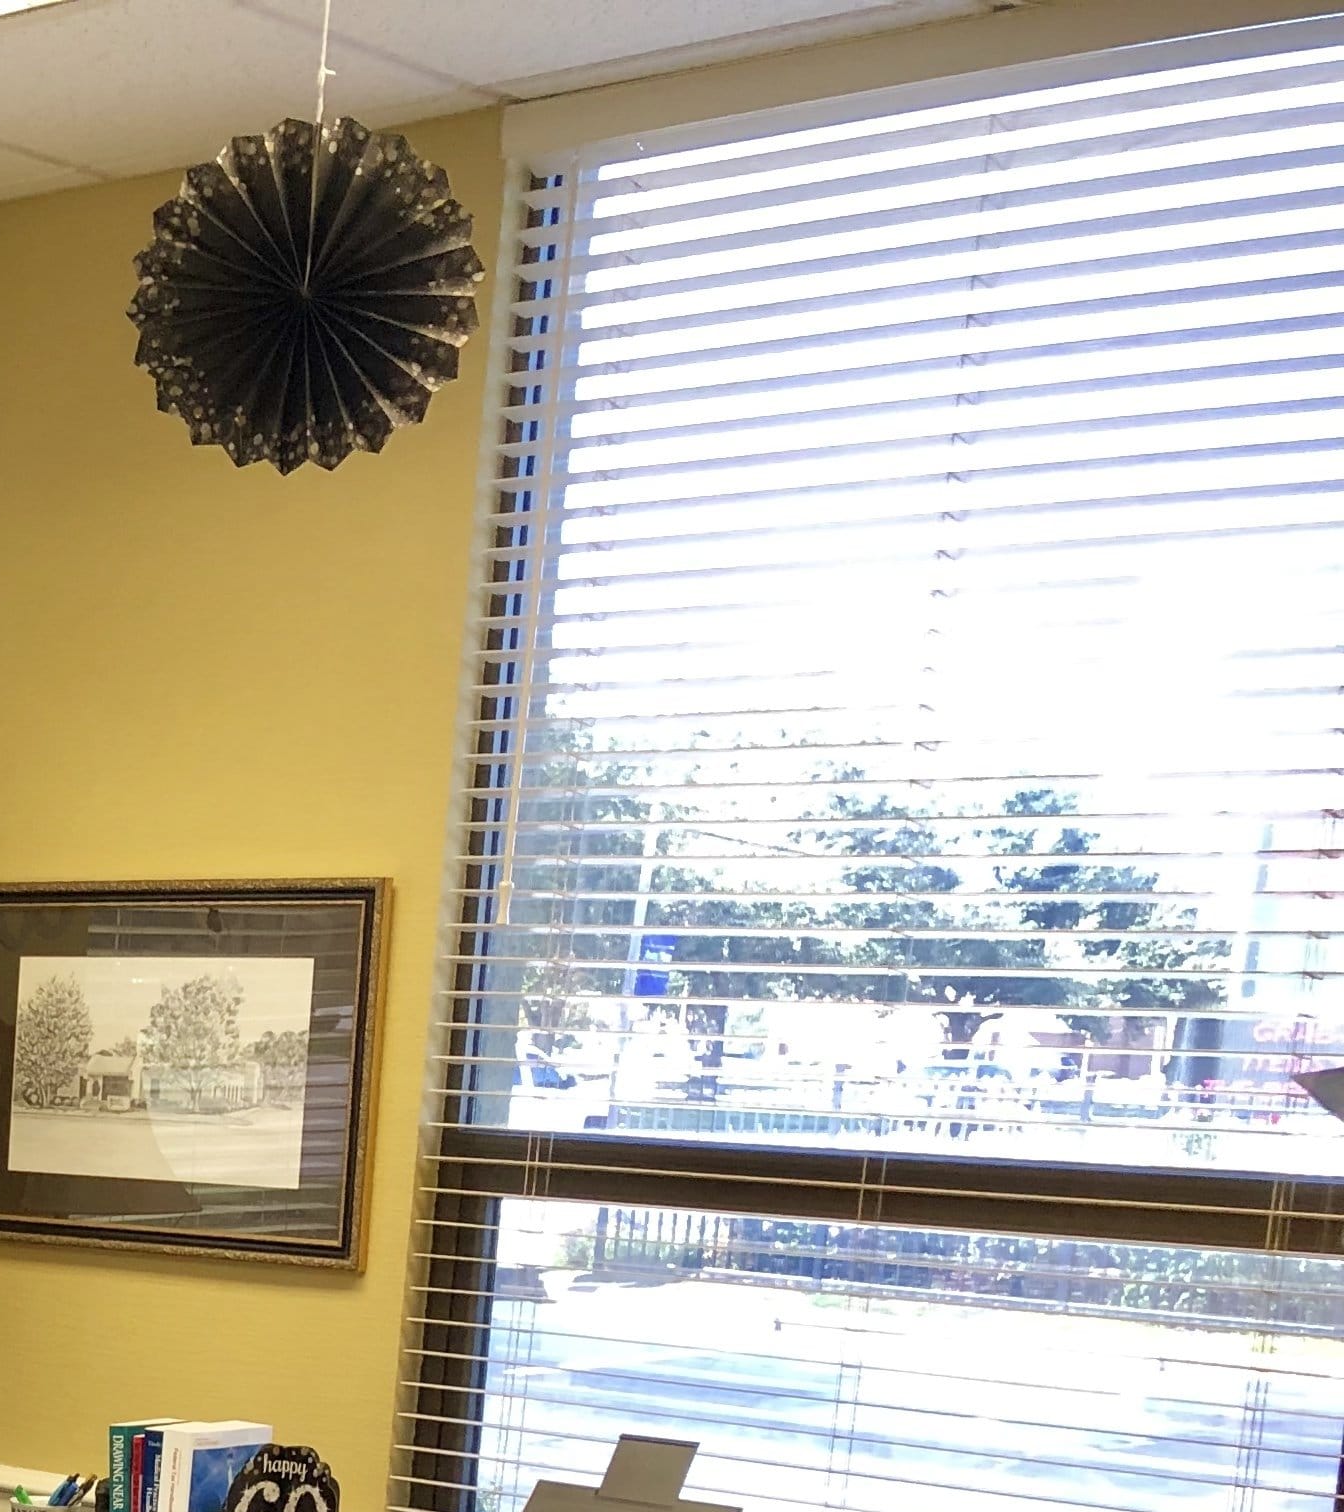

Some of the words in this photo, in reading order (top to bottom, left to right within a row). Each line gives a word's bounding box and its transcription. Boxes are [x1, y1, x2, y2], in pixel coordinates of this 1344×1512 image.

[112, 1434, 125, 1484] DRAWING
[263, 1453, 308, 1482] happy
[112, 1484, 125, 1511] NEAR
